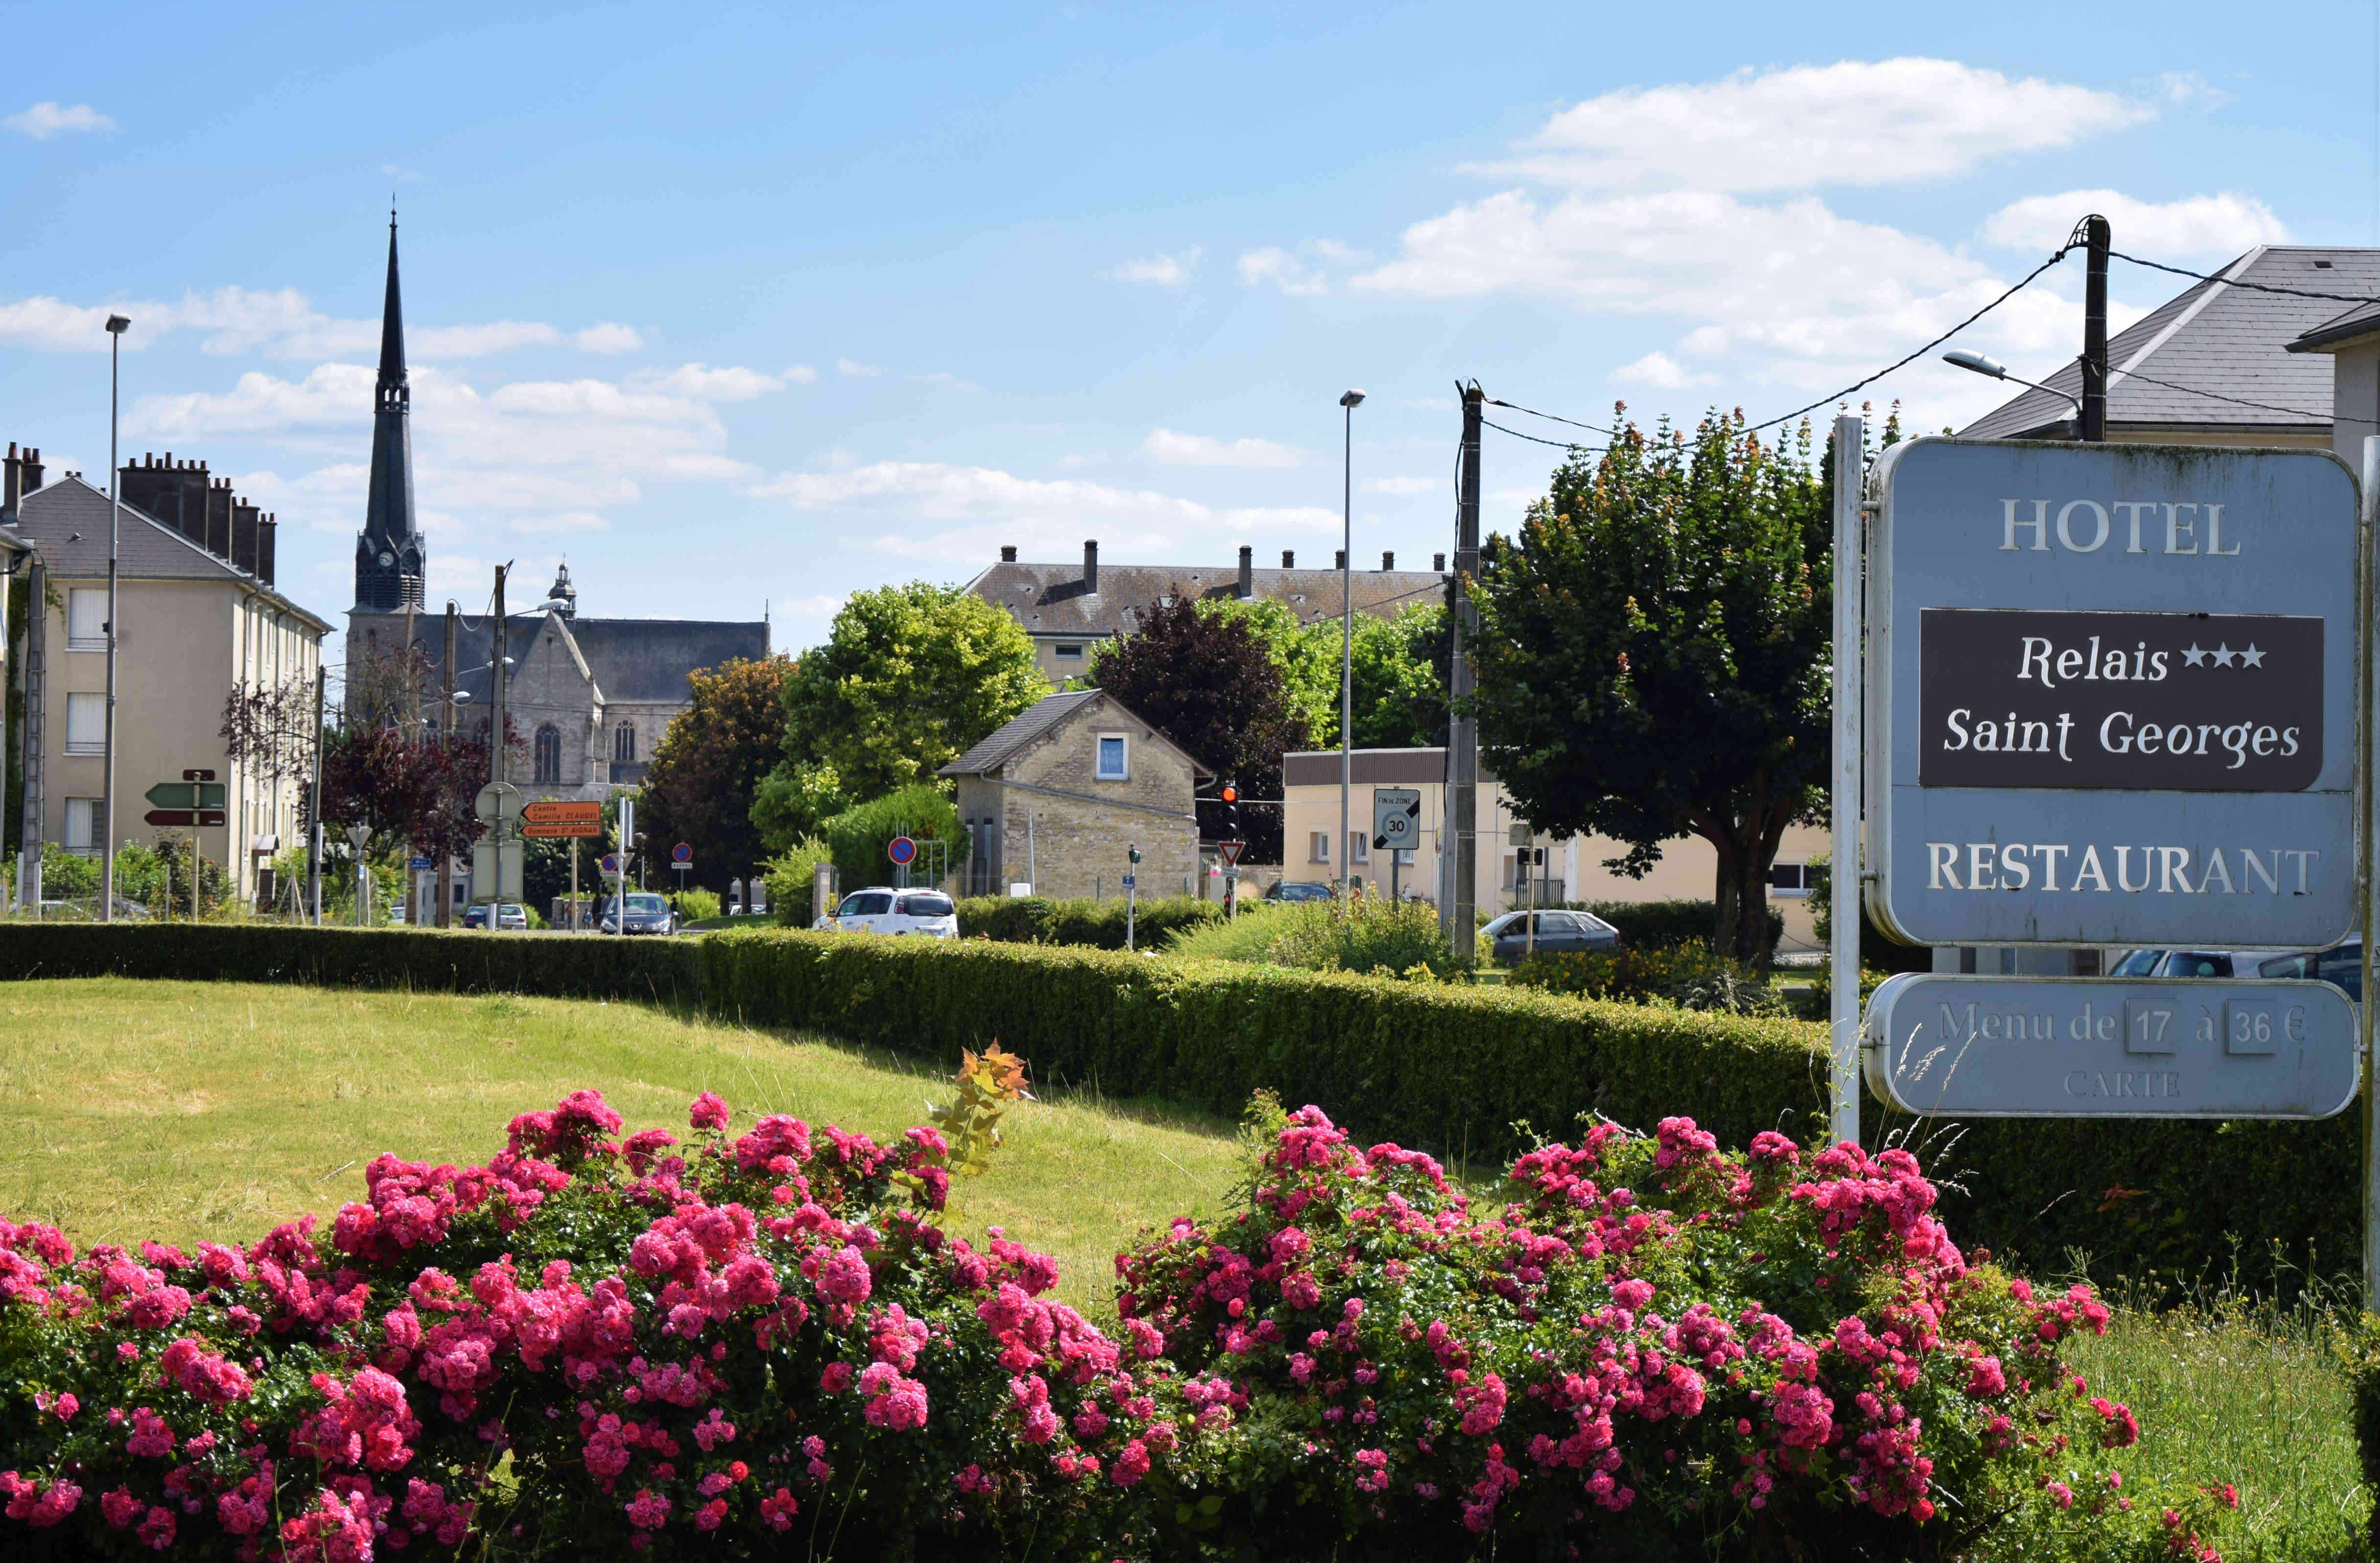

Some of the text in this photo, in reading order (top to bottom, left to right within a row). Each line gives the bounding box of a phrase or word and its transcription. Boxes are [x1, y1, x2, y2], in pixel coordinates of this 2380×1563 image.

[1998, 498, 2241, 556] HOTEL
[2017, 636, 2169, 688] Relais
[1943, 708, 2300, 770] Saint Georges
[1389, 820, 1405, 832] 30
[1926, 842, 2320, 896] RESTAURANT
[1937, 1001, 2306, 1043] Menu de 17 à 36 €
[2064, 1071, 2181, 1098] CARTE
